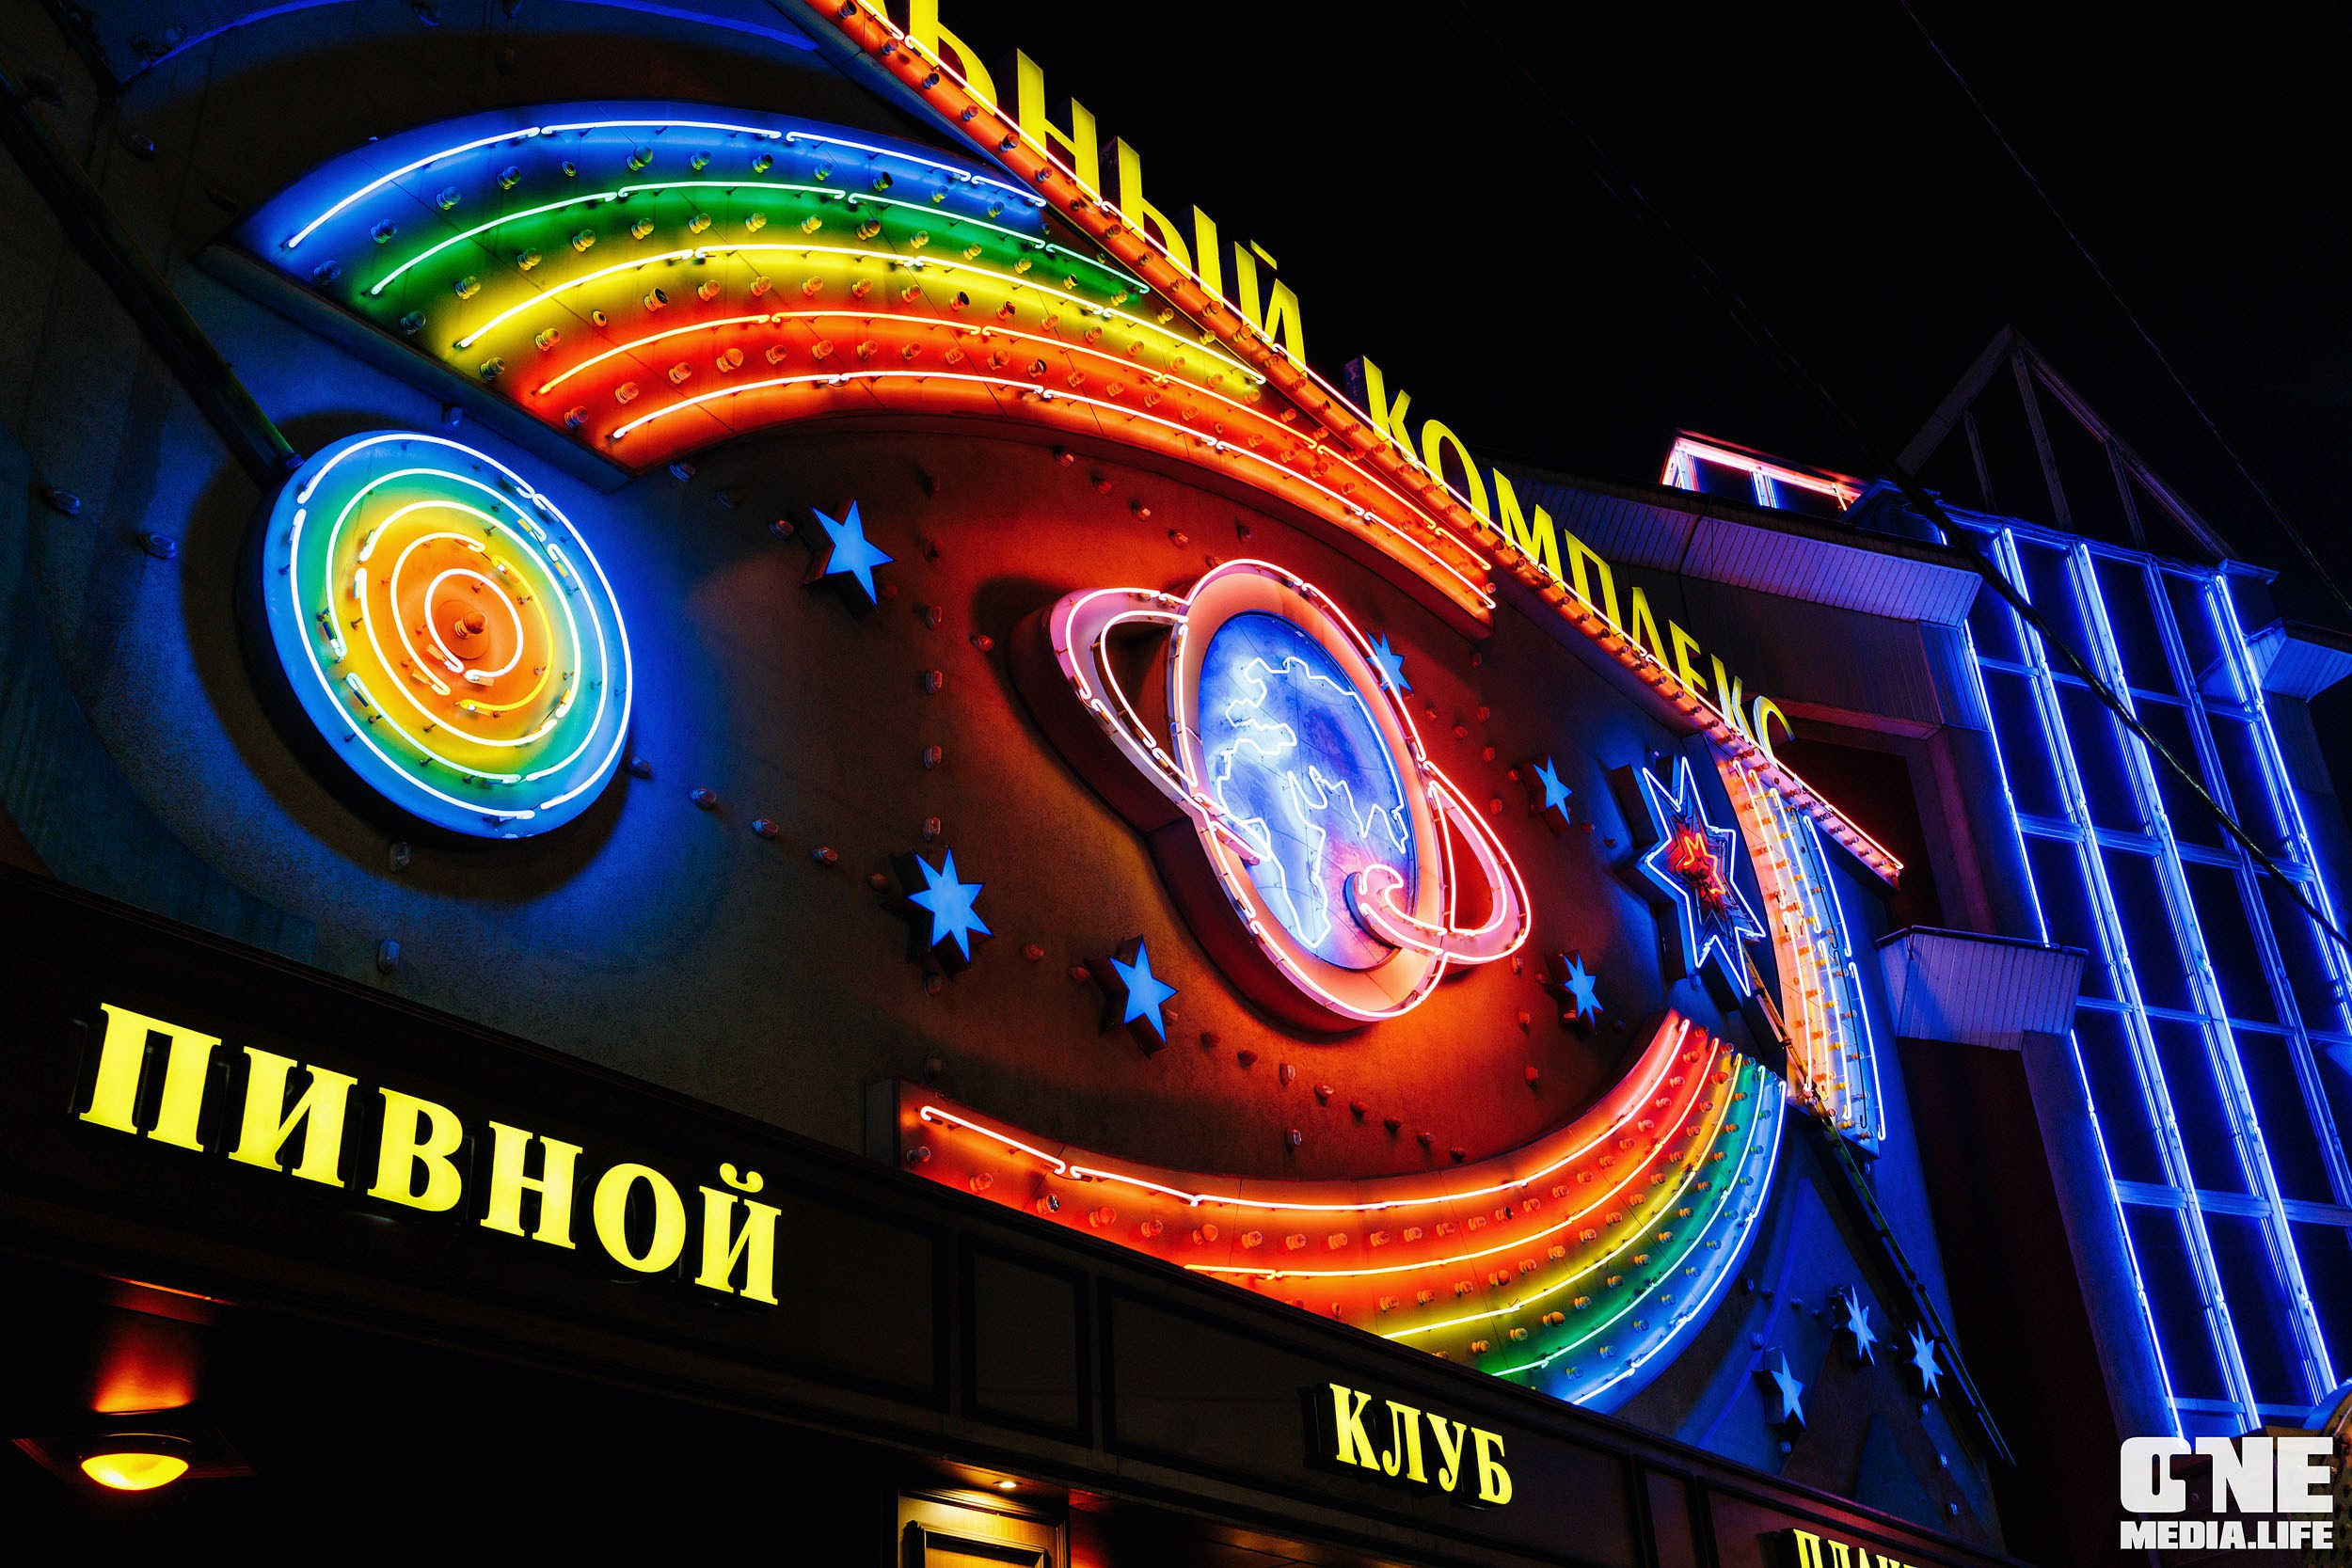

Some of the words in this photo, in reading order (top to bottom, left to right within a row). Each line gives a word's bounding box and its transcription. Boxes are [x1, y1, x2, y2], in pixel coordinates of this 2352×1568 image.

[860, 0, 1306, 376] ЬНЫЙ
[1361, 356, 1795, 769] КОМПЛЕКС
[79, 1003, 782, 1306] ПИВНОЙ
[1329, 1383, 1513, 1505] КЛУБ
